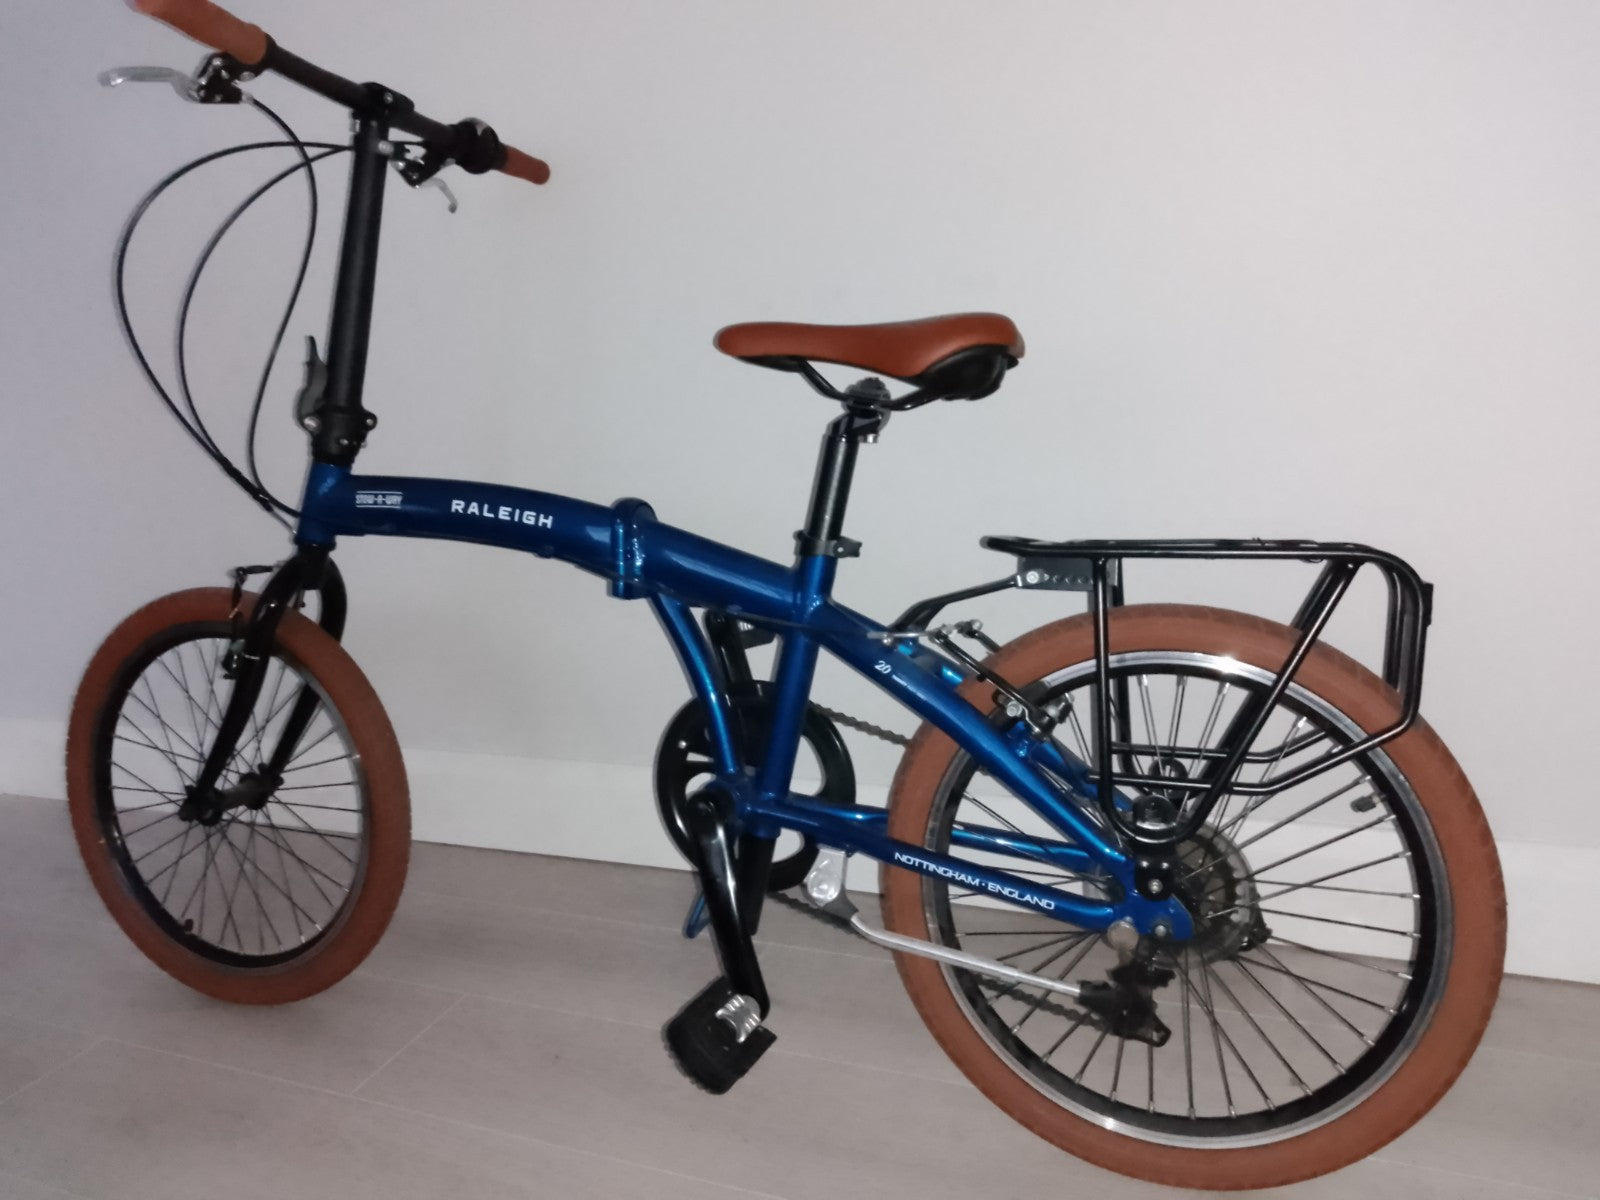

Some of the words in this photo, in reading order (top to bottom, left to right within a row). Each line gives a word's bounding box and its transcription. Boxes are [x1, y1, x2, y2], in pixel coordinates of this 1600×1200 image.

[451, 499, 553, 529] RALEIGH
[874, 660, 892, 674] 20
[894, 852, 979, 886] NOTTINGHAM
[987, 882, 1055, 910] ENGLAND
